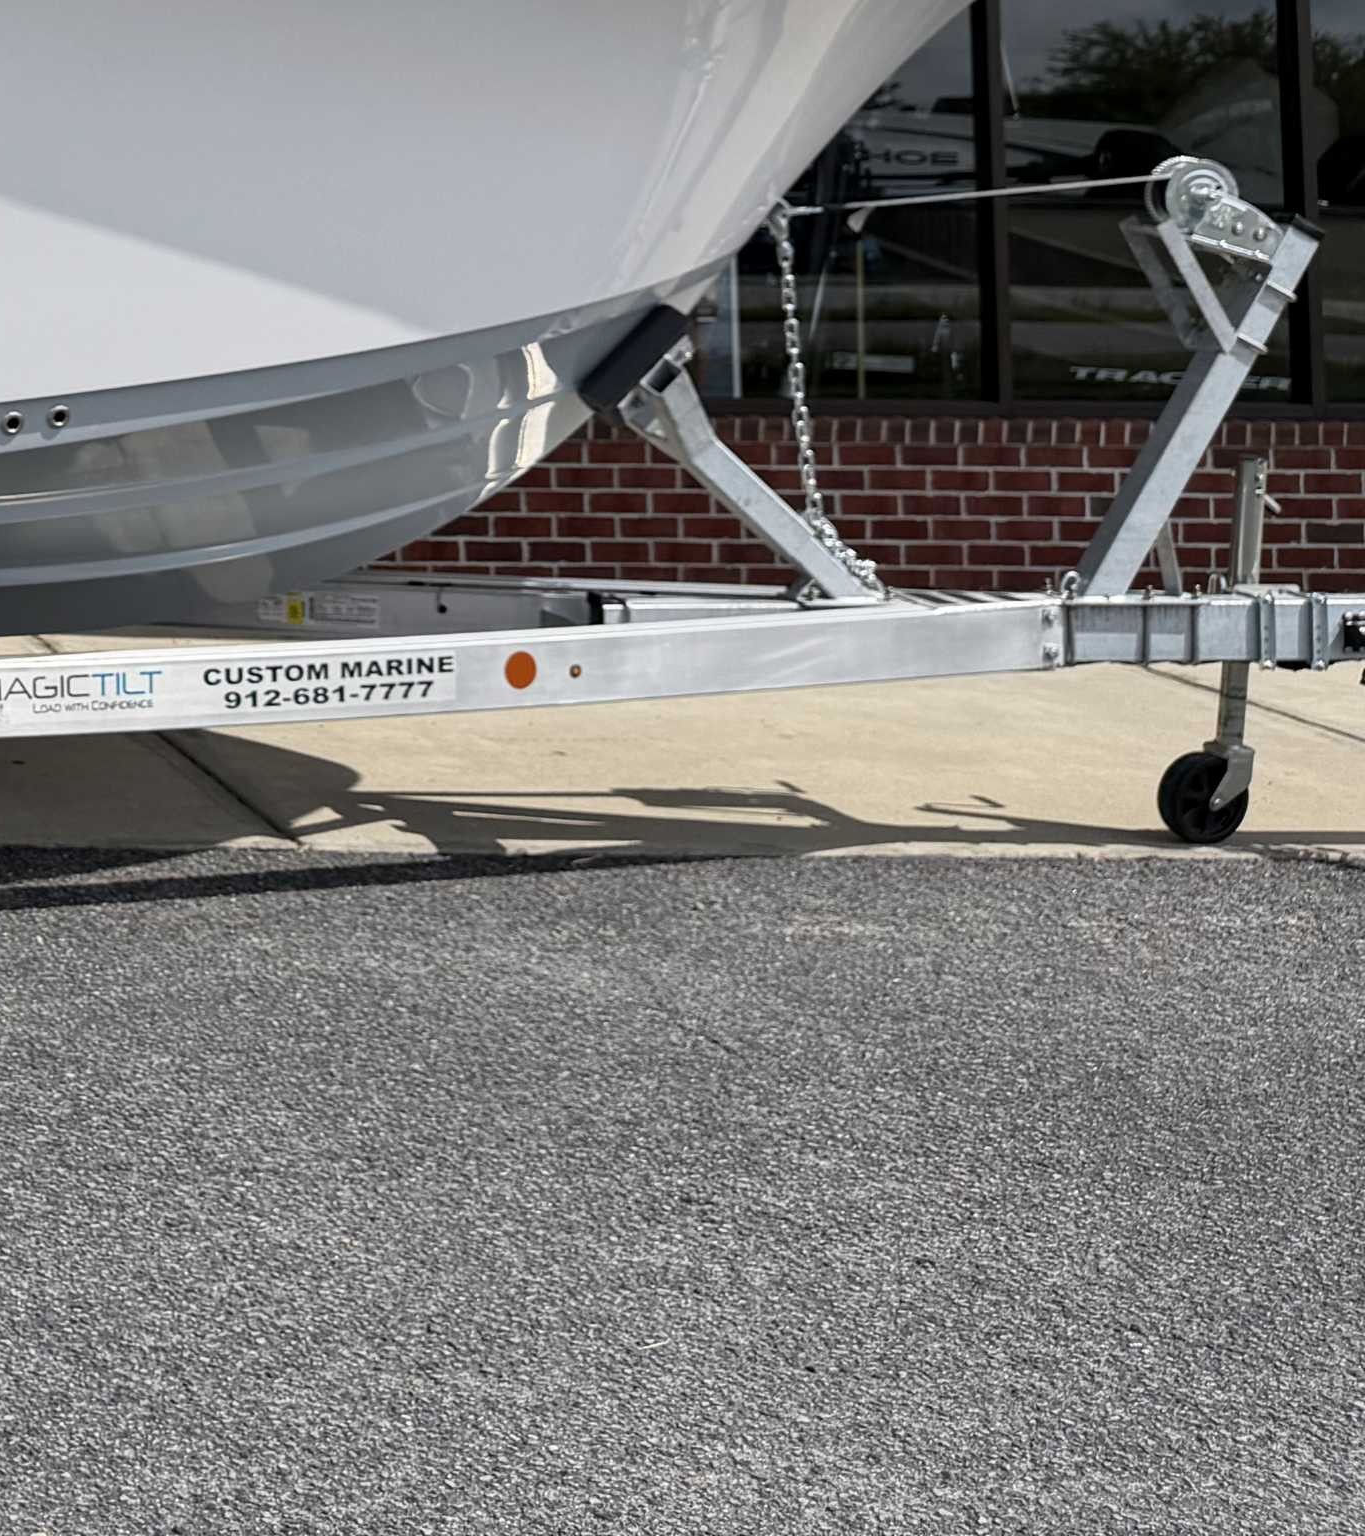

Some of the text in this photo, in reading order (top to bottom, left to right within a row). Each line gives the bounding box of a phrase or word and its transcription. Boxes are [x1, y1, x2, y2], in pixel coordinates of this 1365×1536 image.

[1070, 366, 1292, 392] TRACER
[203, 655, 455, 686] CUSTOM MARINE
[224, 680, 434, 709] 912-681-7777
